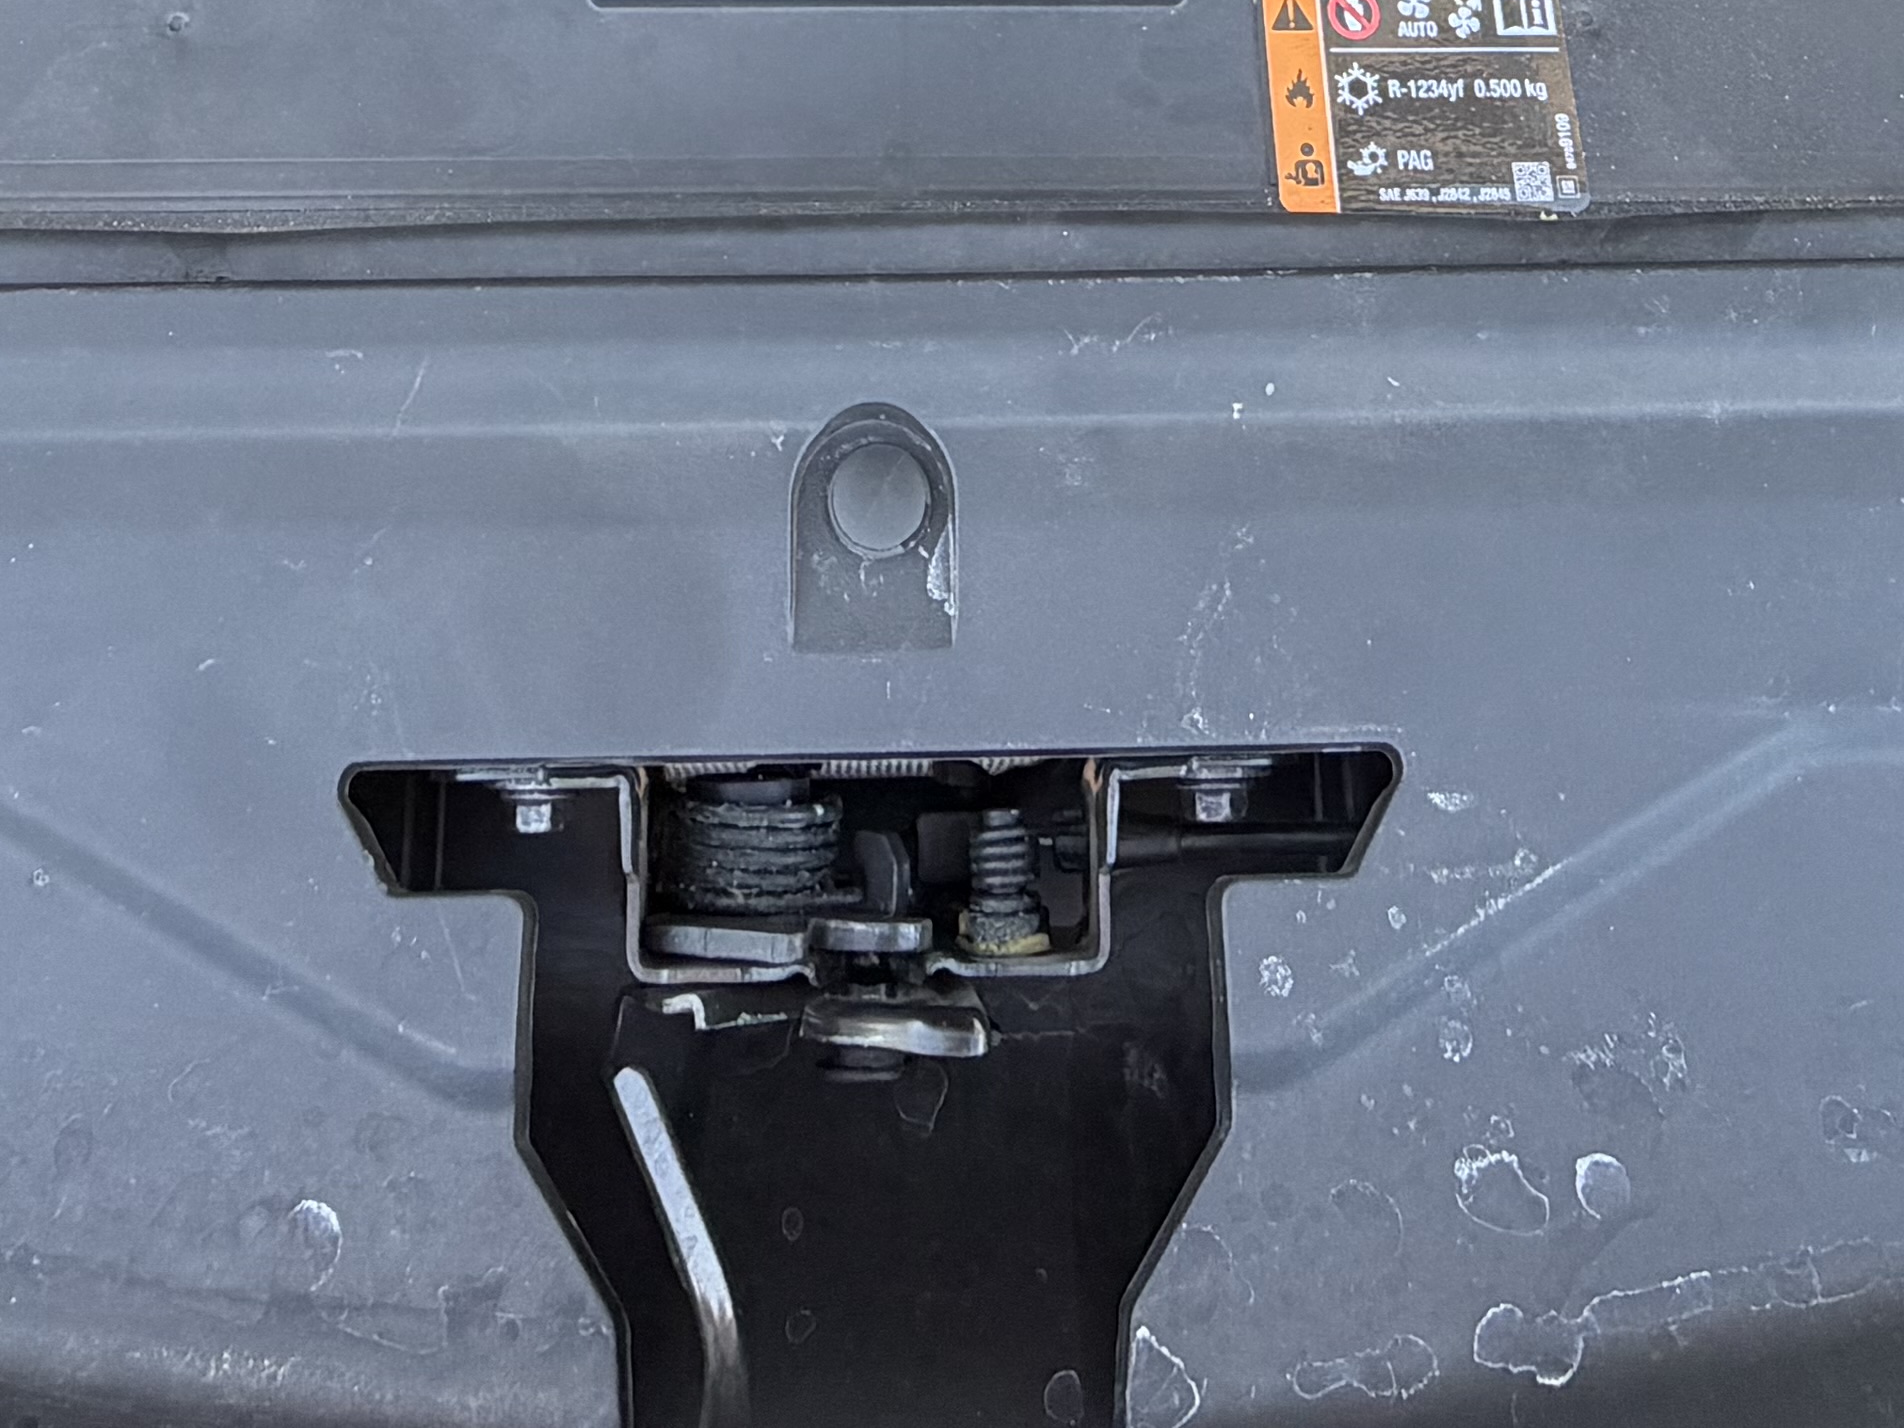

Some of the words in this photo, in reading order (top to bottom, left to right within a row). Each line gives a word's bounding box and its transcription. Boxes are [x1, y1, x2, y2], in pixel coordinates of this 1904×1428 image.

[1397, 21, 1439, 38] AUTO
[1387, 79, 1464, 102] R-1234yf
[1473, 79, 1522, 98] 0.500
[1524, 78, 1549, 101] kg
[1396, 149, 1434, 171] PAG
[1378, 187, 1401, 201] SAE
